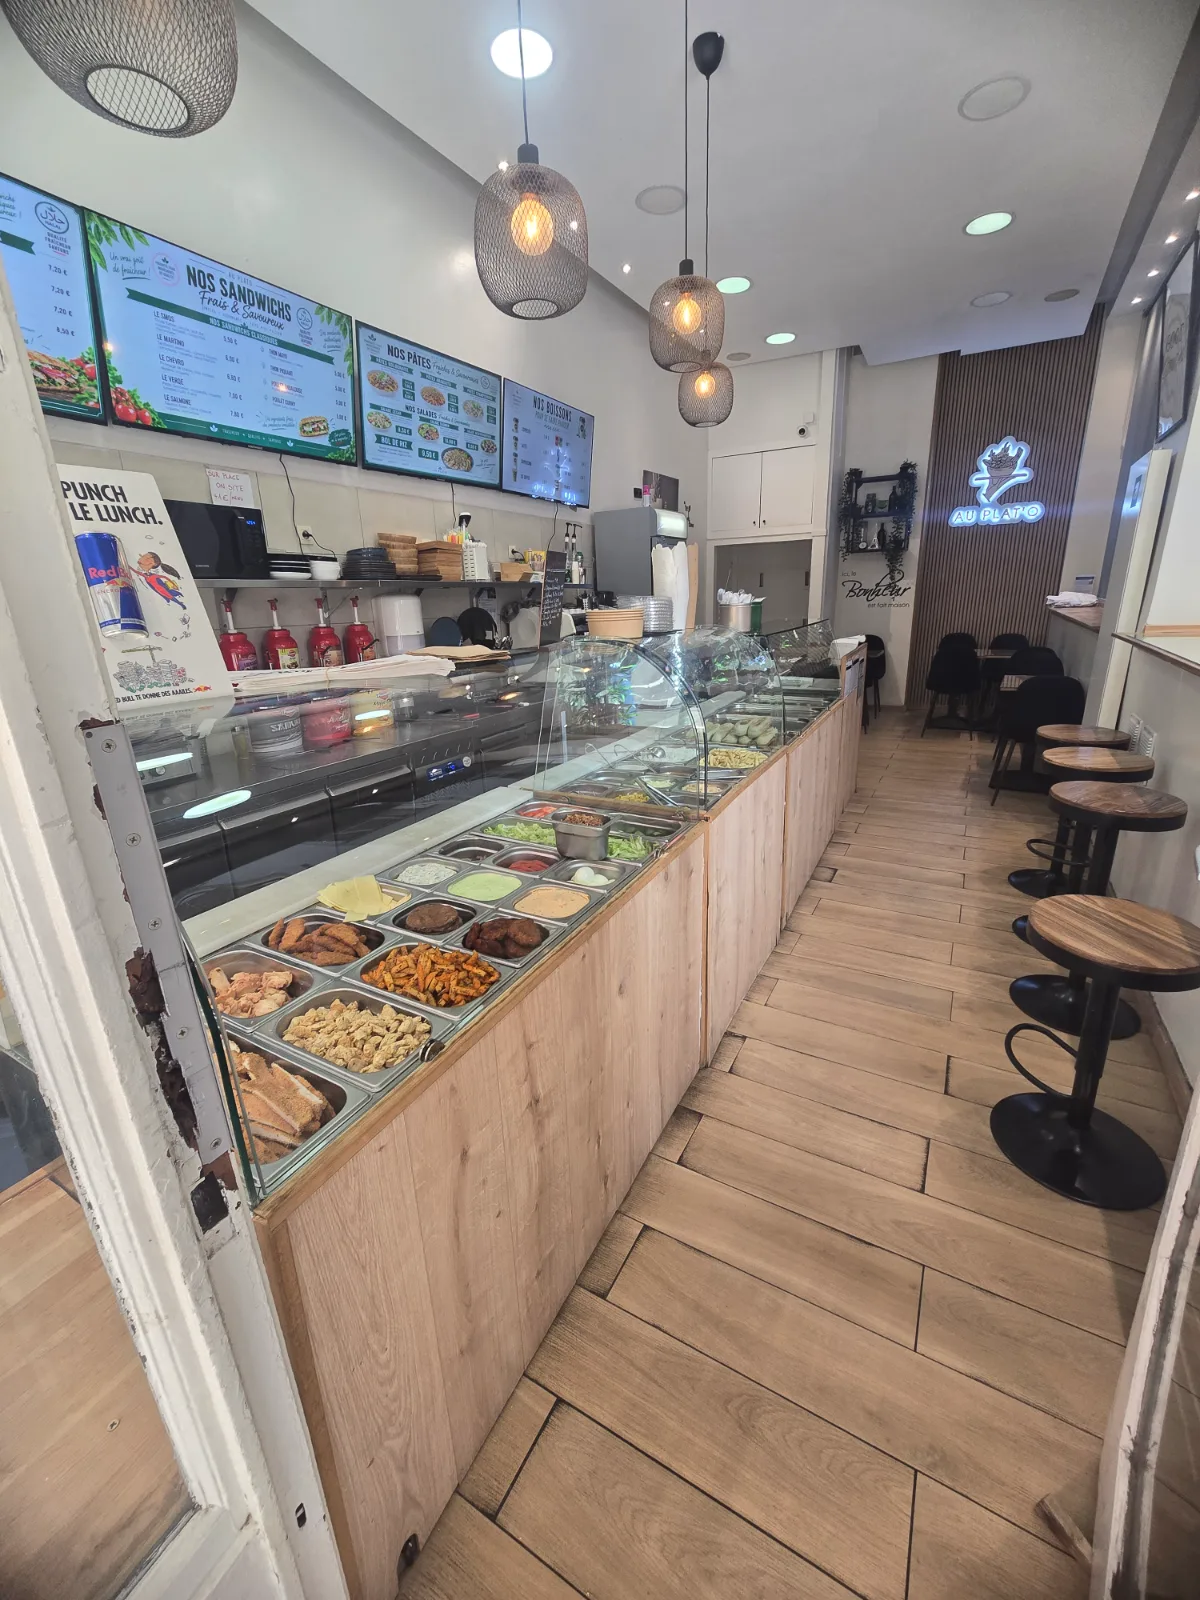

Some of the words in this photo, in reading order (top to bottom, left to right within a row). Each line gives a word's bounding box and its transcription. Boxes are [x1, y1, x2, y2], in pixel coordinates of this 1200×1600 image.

[186, 264, 216, 293] NOS
[219, 277, 292, 322] SANDWICHS
[153, 310, 160, 318] LE
[198, 290, 229, 311] Frais
[230, 300, 240, 315] &
[242, 304, 285, 331] Savoureux
[158, 353, 165, 361] LE
[387, 343, 406, 361] NOS
[407, 351, 432, 370] PÂTES
[161, 373, 168, 382] LE
[405, 404, 416, 413] NOS
[416, 407, 438, 419] SALADES
[533, 395, 545, 411] NOS
[546, 402, 572, 422] BOISSONS
[380, 436, 391, 445] BOL
[392, 438, 399, 447] DE
[207, 470, 220, 478] SUR
[60, 480, 128, 503] PUNCH
[68, 501, 94, 521] LE
[93, 503, 163, 525] LUNCH.
[954, 510, 975, 522] AU
[982, 506, 1039, 521] PLAT'O
[88, 565, 117, 579] Red
[841, 568, 911, 602] Bonheur
[121, 695, 135, 703] BULL
[142, 691, 161, 700] DONNE
